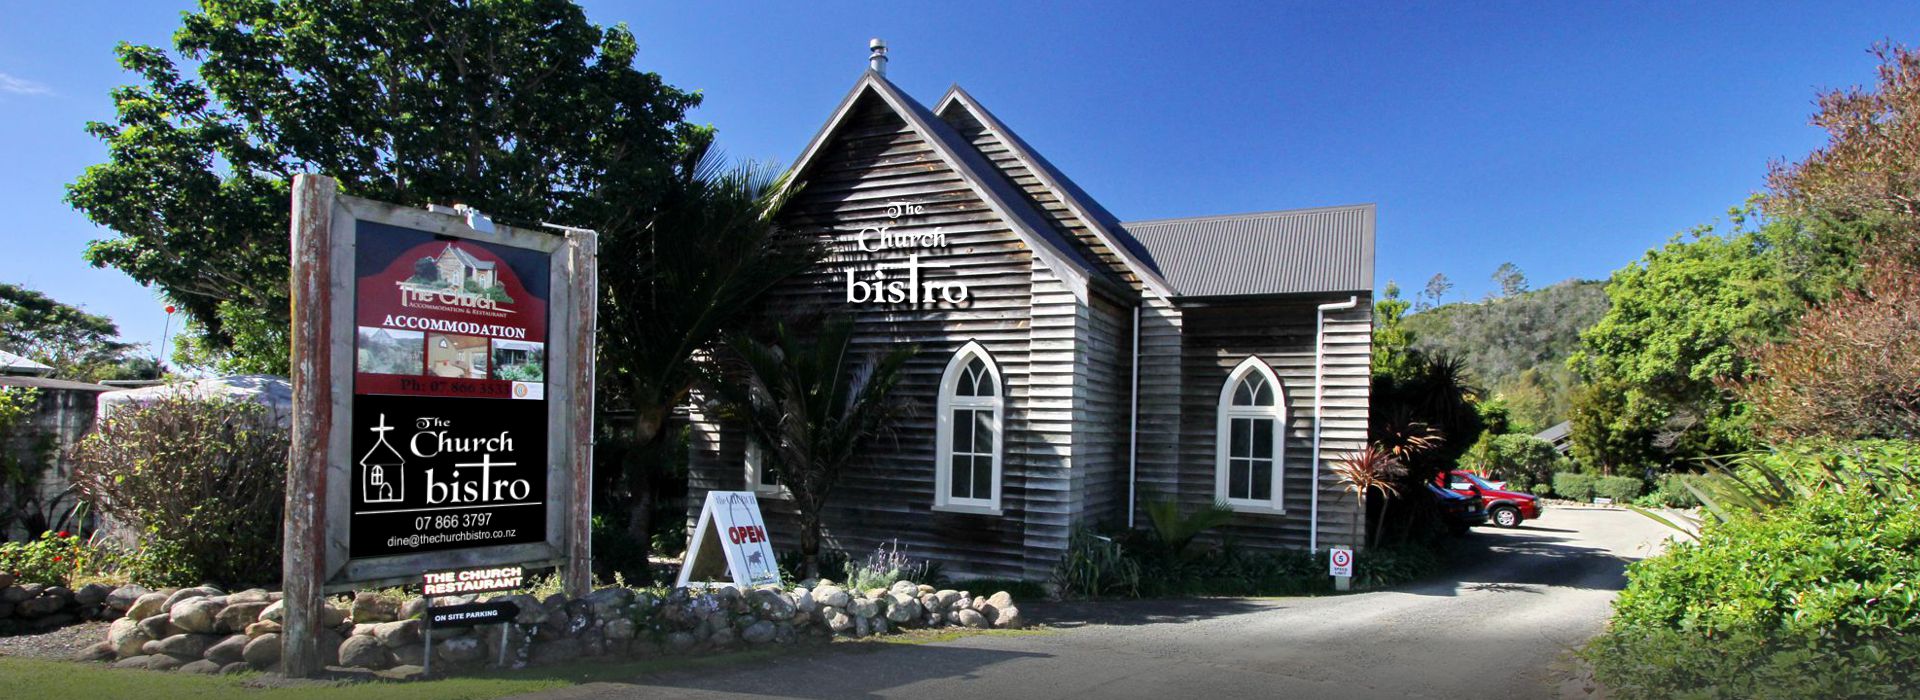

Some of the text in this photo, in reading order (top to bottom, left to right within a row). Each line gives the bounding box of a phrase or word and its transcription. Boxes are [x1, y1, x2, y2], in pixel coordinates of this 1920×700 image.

[887, 201, 923, 219] The
[858, 226, 948, 252] Church
[846, 253, 968, 304] bistro
[396, 280, 434, 307] The
[383, 314, 526, 339] ACCOMMODATION
[416, 417, 451, 429] The
[410, 430, 515, 458] Church
[424, 453, 531, 505] bistro
[415, 512, 493, 531] 07 866 3797
[387, 528, 516, 547] dine@thechurchbistro.co.nz
[728, 525, 767, 545] OPEN
[1338, 555, 1344, 563] 5
[424, 567, 522, 584] THE CHURCH
[424, 576, 523, 595] RESTAURANT
[434, 609, 498, 622] ON SITE PARKING
